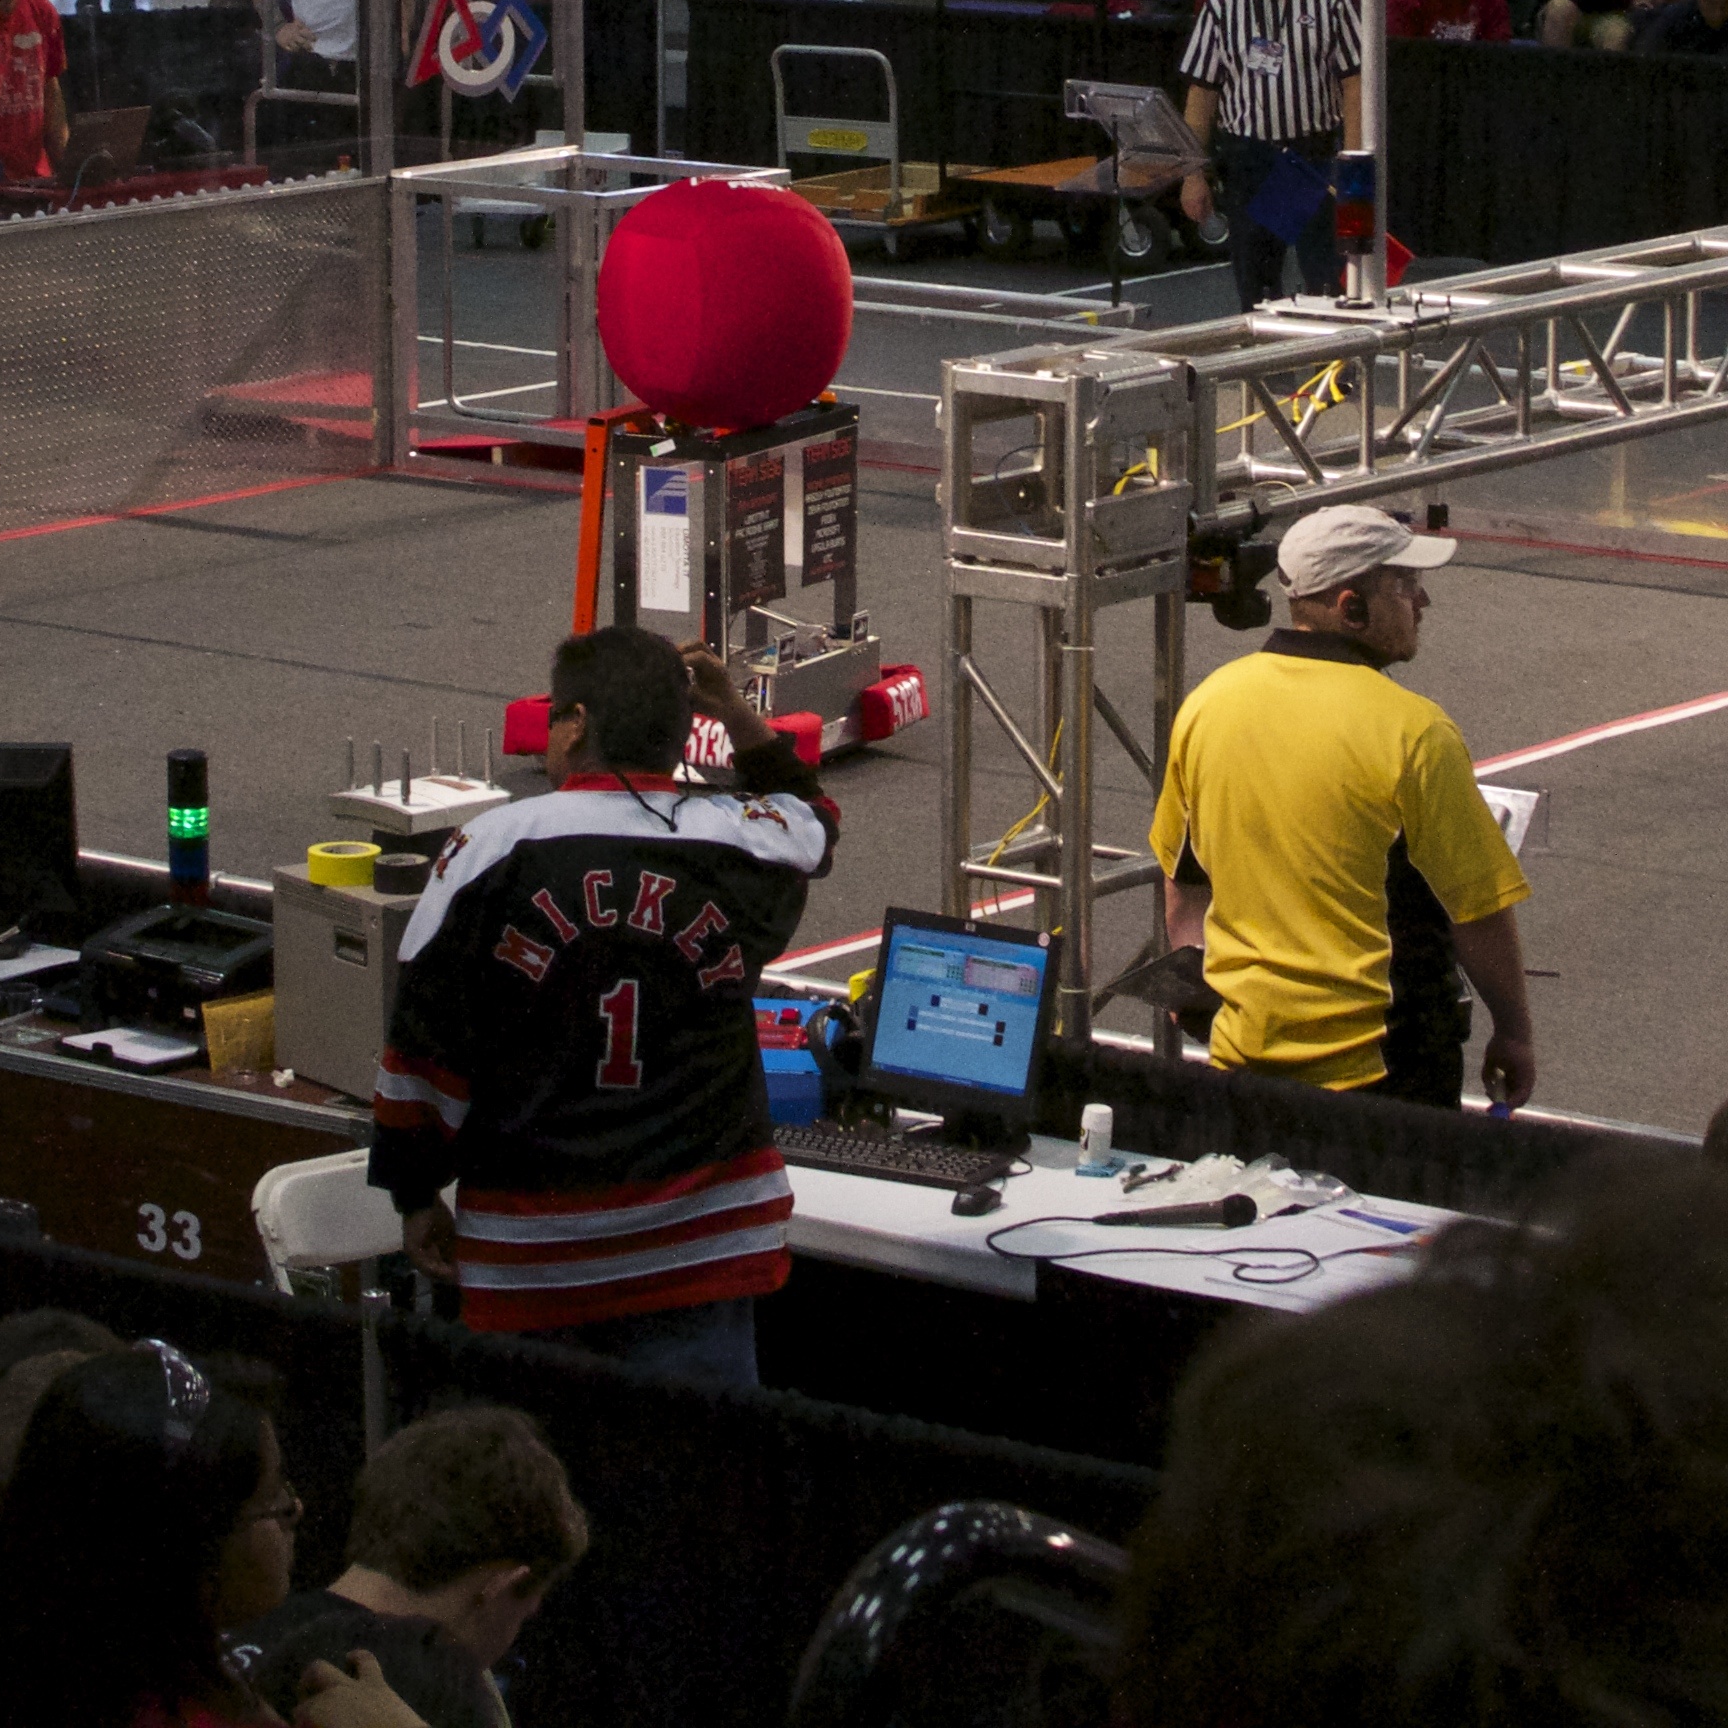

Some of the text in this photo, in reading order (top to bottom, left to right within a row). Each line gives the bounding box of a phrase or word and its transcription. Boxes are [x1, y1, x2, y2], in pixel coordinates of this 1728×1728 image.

[492, 869, 745, 990] MICKEY
[596, 978, 644, 1089] 1
[136, 1202, 202, 1261] 33
